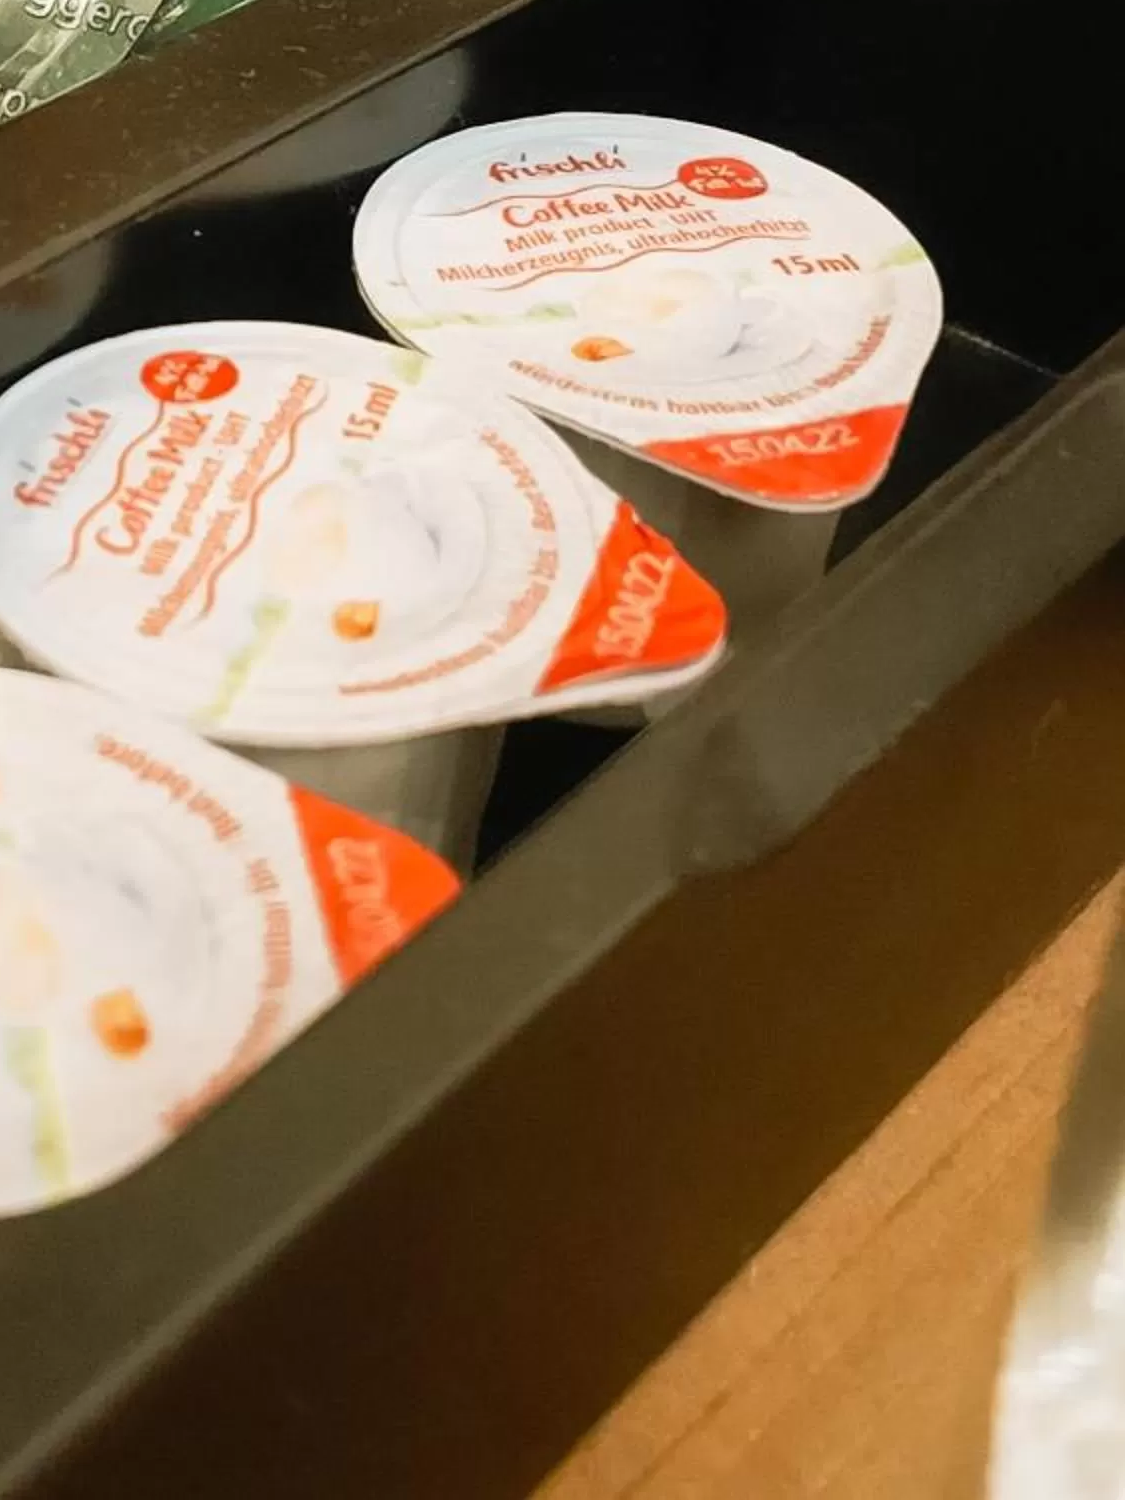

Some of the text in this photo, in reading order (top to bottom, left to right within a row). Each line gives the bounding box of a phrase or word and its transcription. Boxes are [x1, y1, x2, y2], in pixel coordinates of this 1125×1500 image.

[488, 145, 628, 184] frischli
[502, 191, 696, 229] Coffee Milk
[504, 209, 719, 253] Milk product UHT
[94, 465, 175, 556] Coffee
